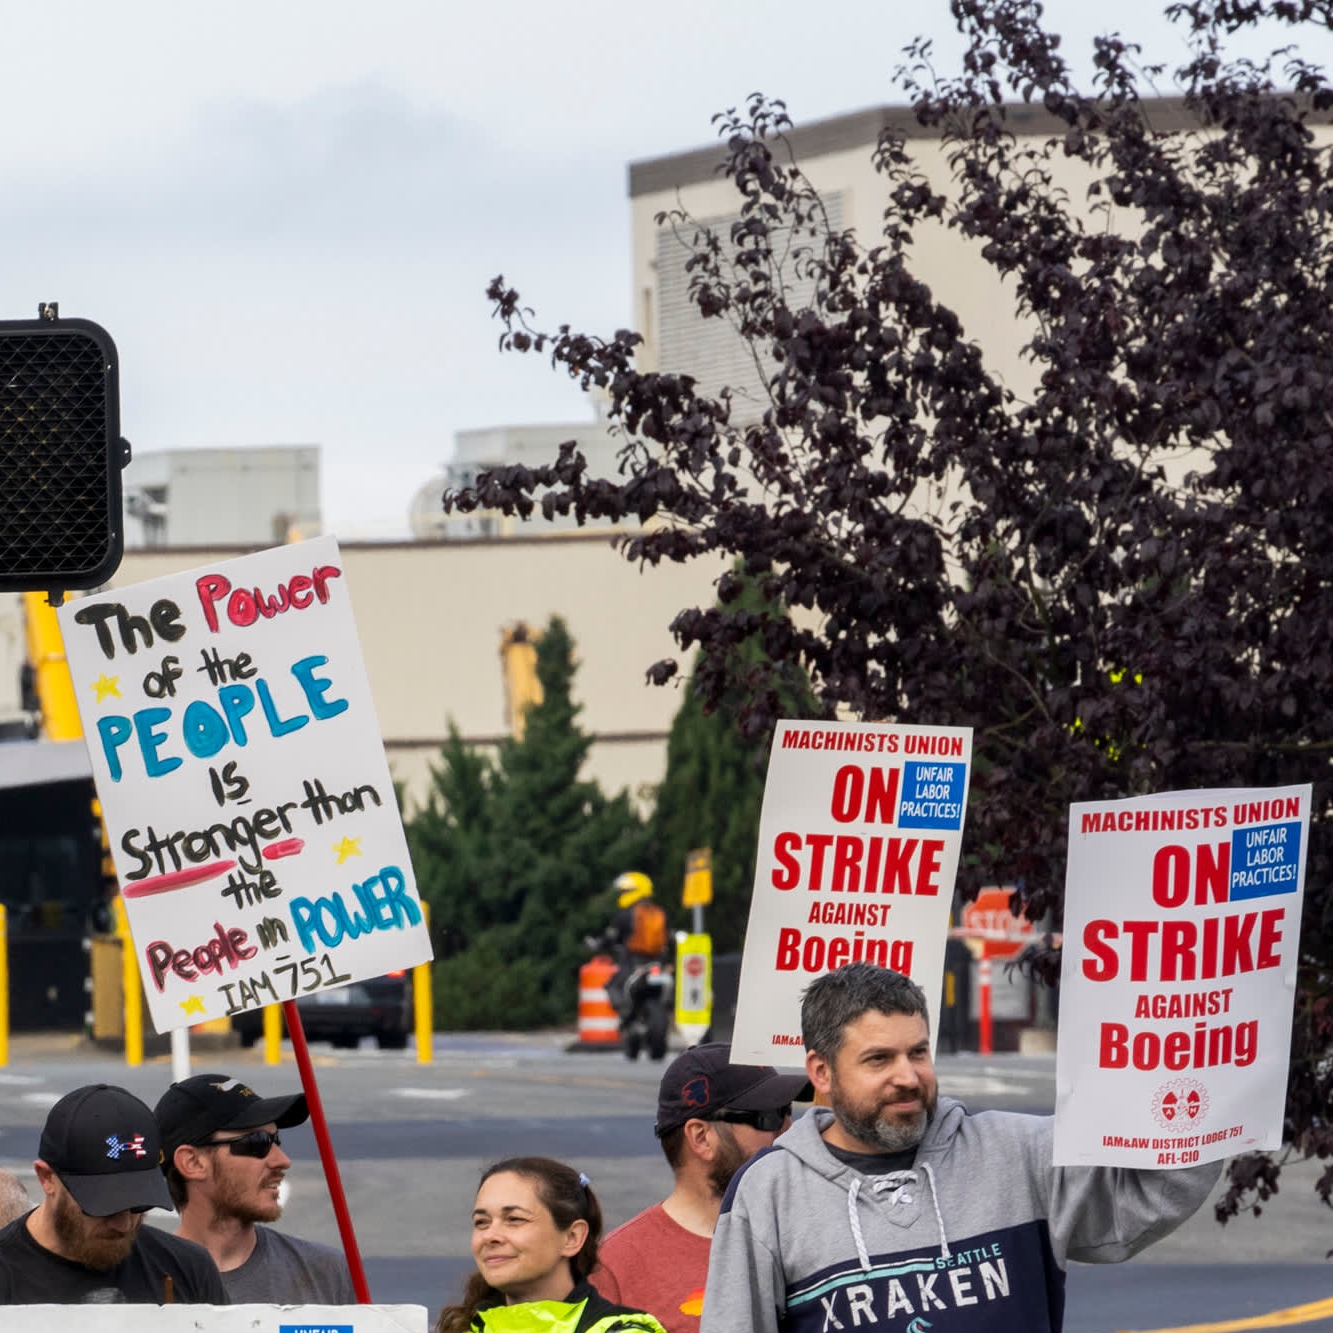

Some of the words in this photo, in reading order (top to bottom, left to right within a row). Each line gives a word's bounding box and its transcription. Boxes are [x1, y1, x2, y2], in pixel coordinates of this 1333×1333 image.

[75, 599, 186, 660] The
[196, 565, 342, 633] Power
[143, 655, 183, 699] of
[196, 647, 258, 686] the
[96, 655, 350, 783] PEOPLE
[782, 730, 899, 753] MACHINISTS
[904, 735, 963, 756] UNION
[916, 767, 953, 782] UNFAIR
[916, 784, 949, 799] LABOR
[831, 764, 900, 825] ON
[901, 802, 961, 818] PRACTICES!
[121, 801, 298, 879] Stronger
[301, 778, 383, 826] than
[1082, 807, 1227, 832] MACHINISTS
[1233, 798, 1299, 825] UNION
[1247, 828, 1286, 847] UNFAIR
[771, 832, 945, 896] STRIKE
[1248, 847, 1283, 866] LABOR
[221, 868, 282, 910] the
[1152, 842, 1230, 908] ON
[1233, 865, 1296, 887] PRACTICES!
[145, 920, 259, 994] People
[289, 864, 422, 955] POWER
[808, 901, 891, 926] AGAINST
[1082, 908, 1285, 982] STRIKE
[218, 970, 280, 1017] IAM
[272, 953, 352, 997] 751
[1135, 989, 1232, 1019] AGAINST
[1099, 1021, 1258, 1071] Boeing
[1103, 1135, 1149, 1148] IAM&AW
[1152, 1135, 1199, 1150] DISTRICT
[1202, 1130, 1228, 1146] LODGE
[1229, 1125, 1243, 1139] 751
[1157, 1150, 1199, 1164] AFL-CIO
[935, 1243, 1003, 1270] SEATTLE
